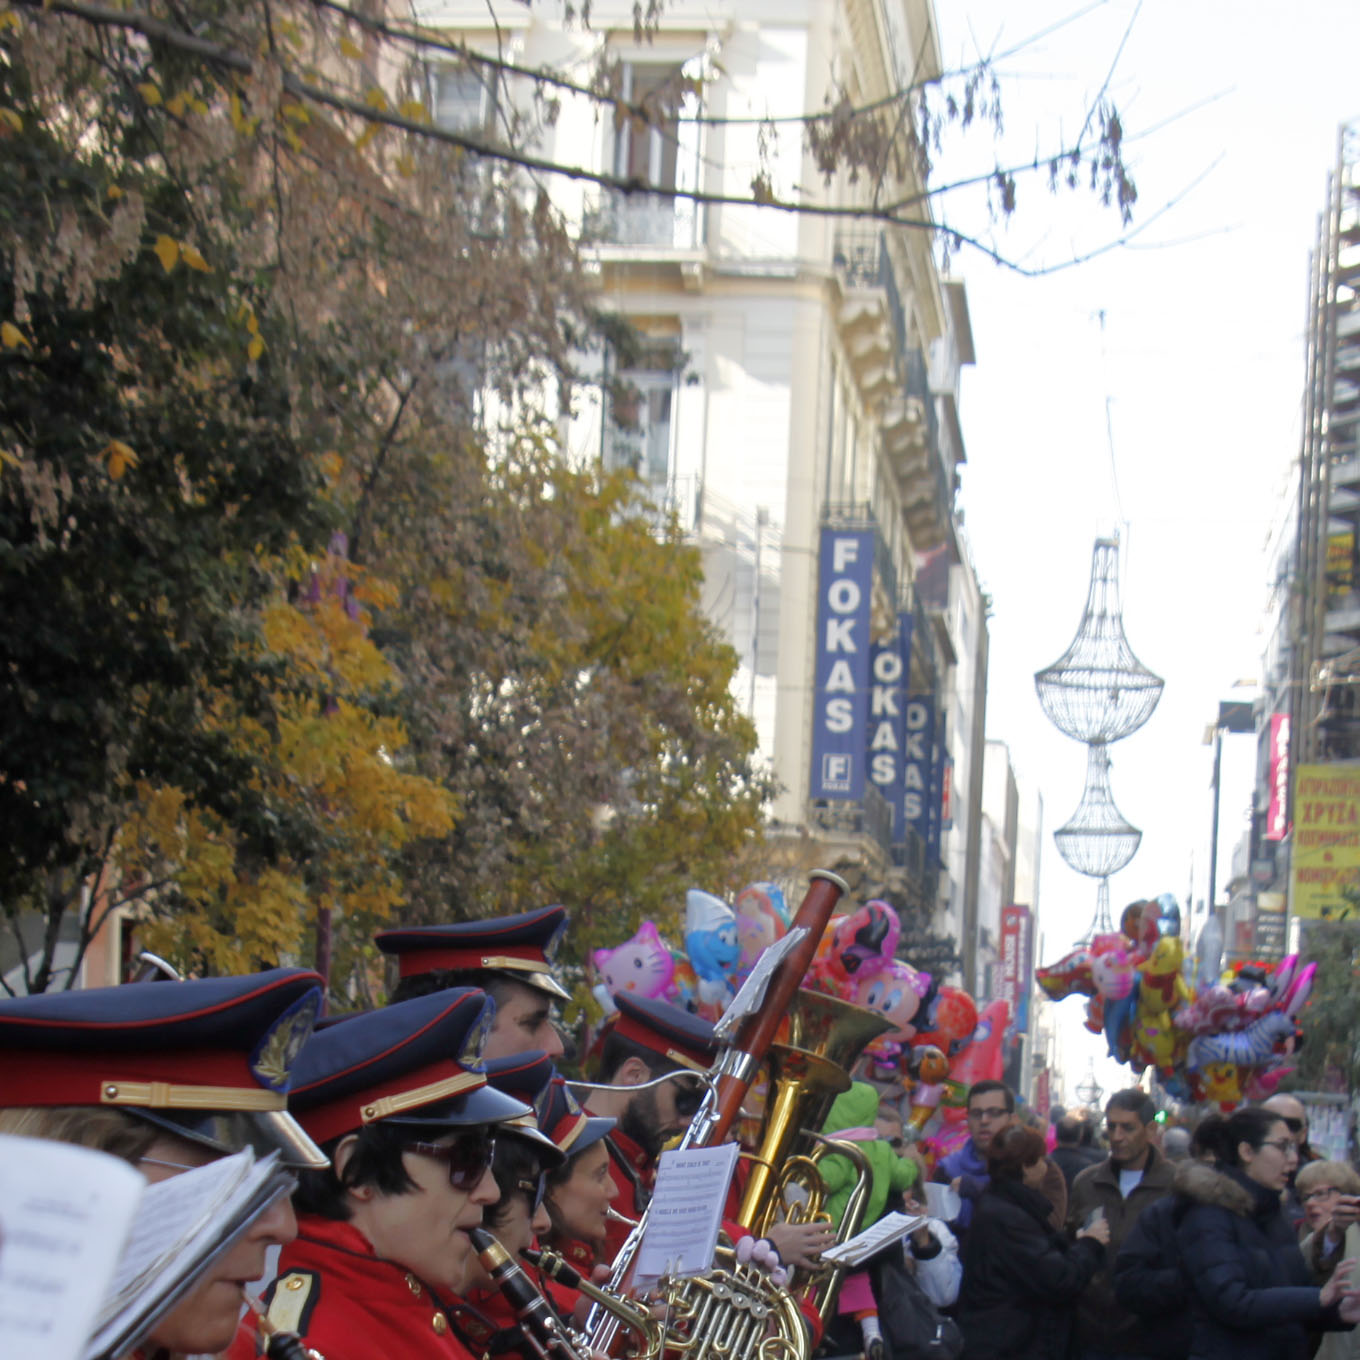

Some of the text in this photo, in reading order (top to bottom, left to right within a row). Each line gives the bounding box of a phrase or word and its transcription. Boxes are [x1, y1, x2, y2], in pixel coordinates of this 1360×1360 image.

[824, 537, 862, 734] FOKAS
[870, 637, 903, 786] OKAS
[904, 702, 928, 821] OKAS
[1302, 801, 1359, 825] ΧΡΥΣΑ
